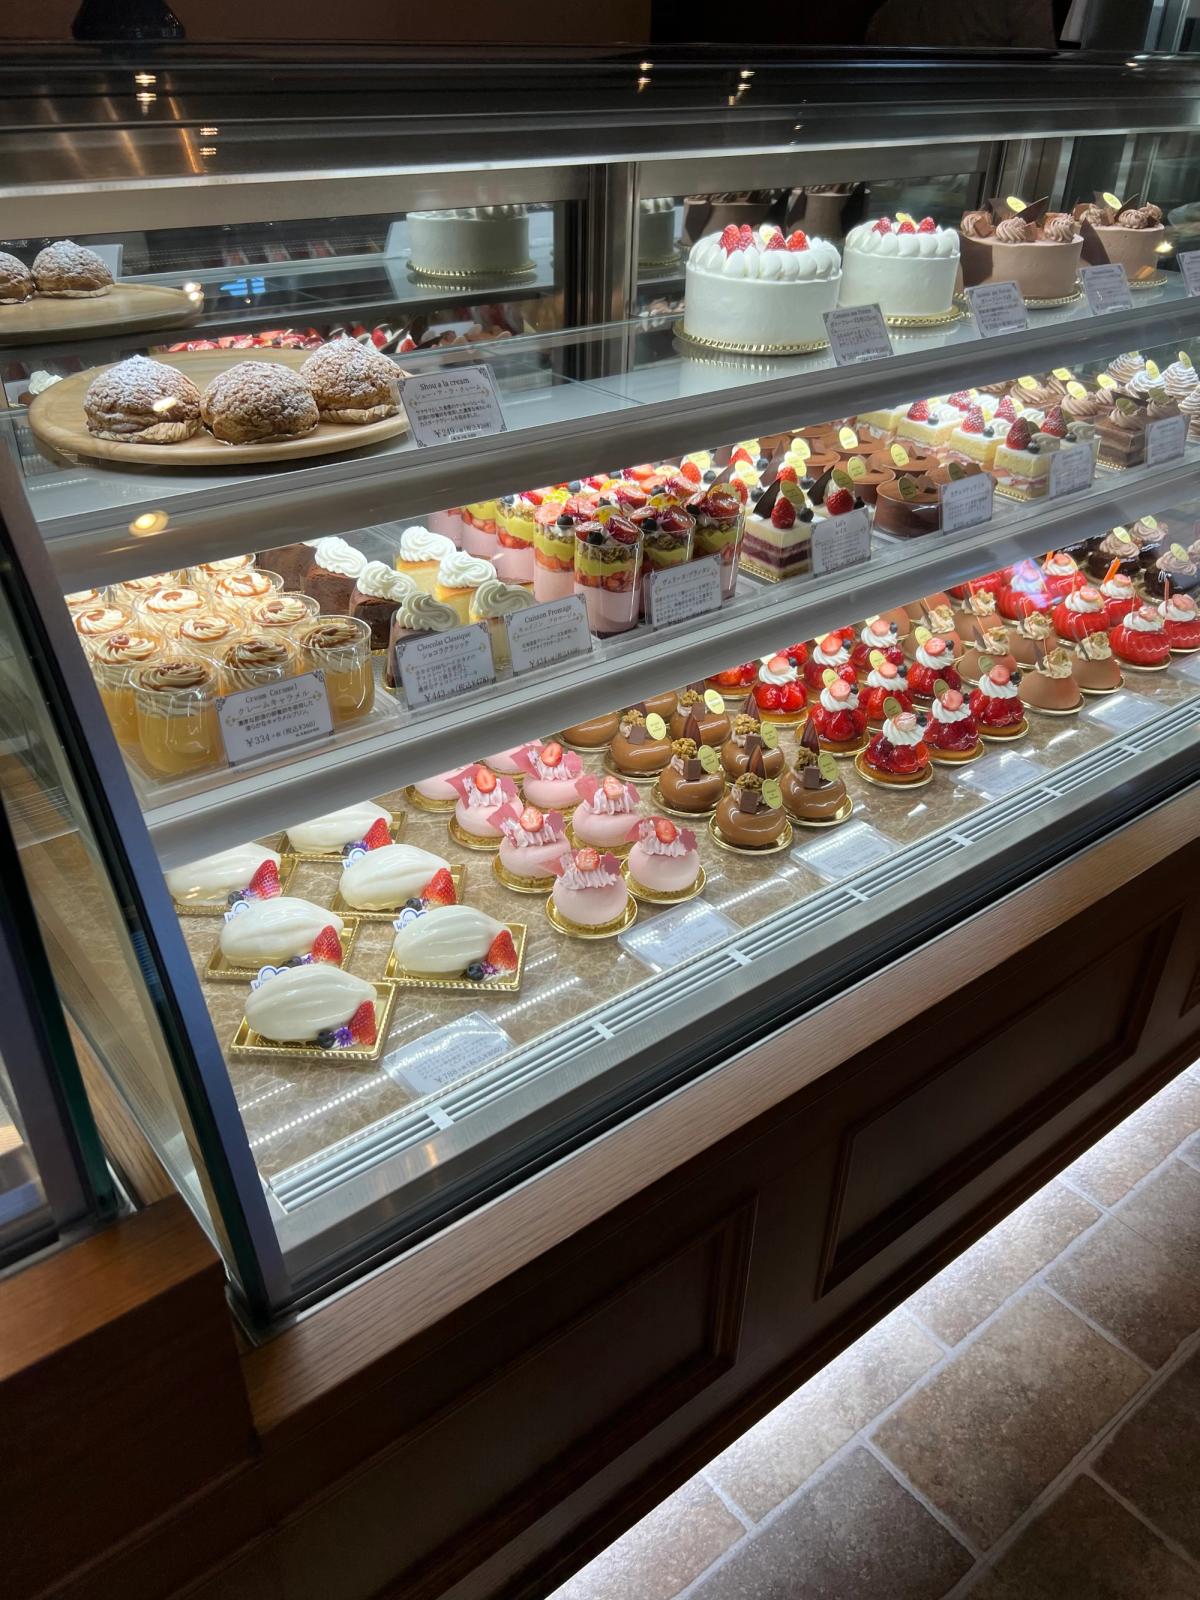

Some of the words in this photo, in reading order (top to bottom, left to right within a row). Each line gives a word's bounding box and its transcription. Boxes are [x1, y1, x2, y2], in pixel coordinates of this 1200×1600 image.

[547, 605, 571, 617] Fromage
[417, 638, 443, 651] Chocolat
[443, 629, 471, 646] Classique
[238, 691, 309, 715] クレームキャラメル
